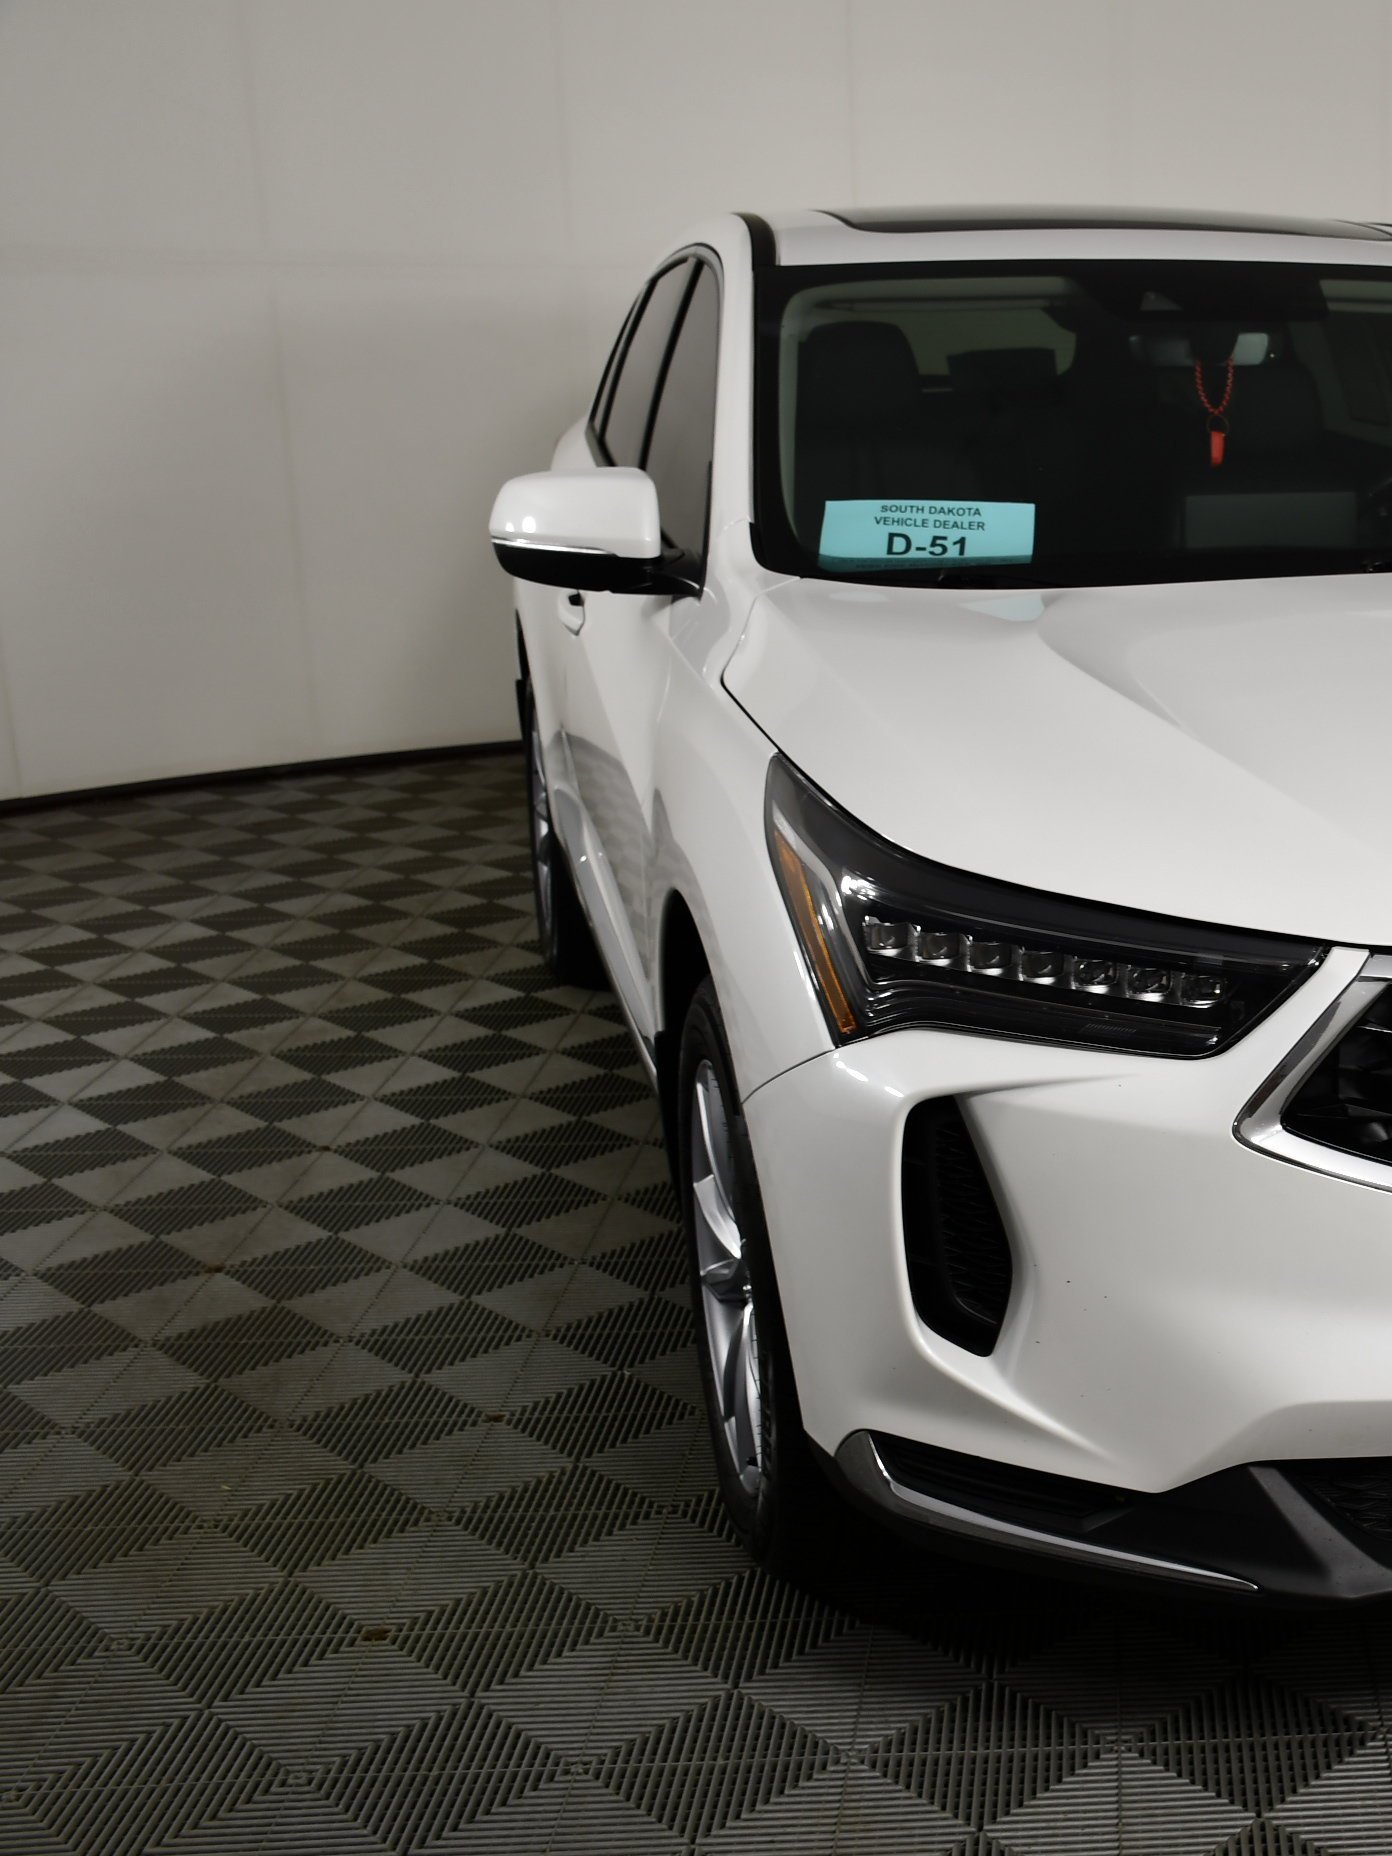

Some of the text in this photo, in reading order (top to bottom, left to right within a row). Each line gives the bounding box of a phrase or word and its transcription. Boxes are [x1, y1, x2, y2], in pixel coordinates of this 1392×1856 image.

[880, 504, 982, 517] SOUTH DAKOTA
[874, 516, 985, 531] VEHICLE DEALER
[886, 532, 967, 557] D-51
